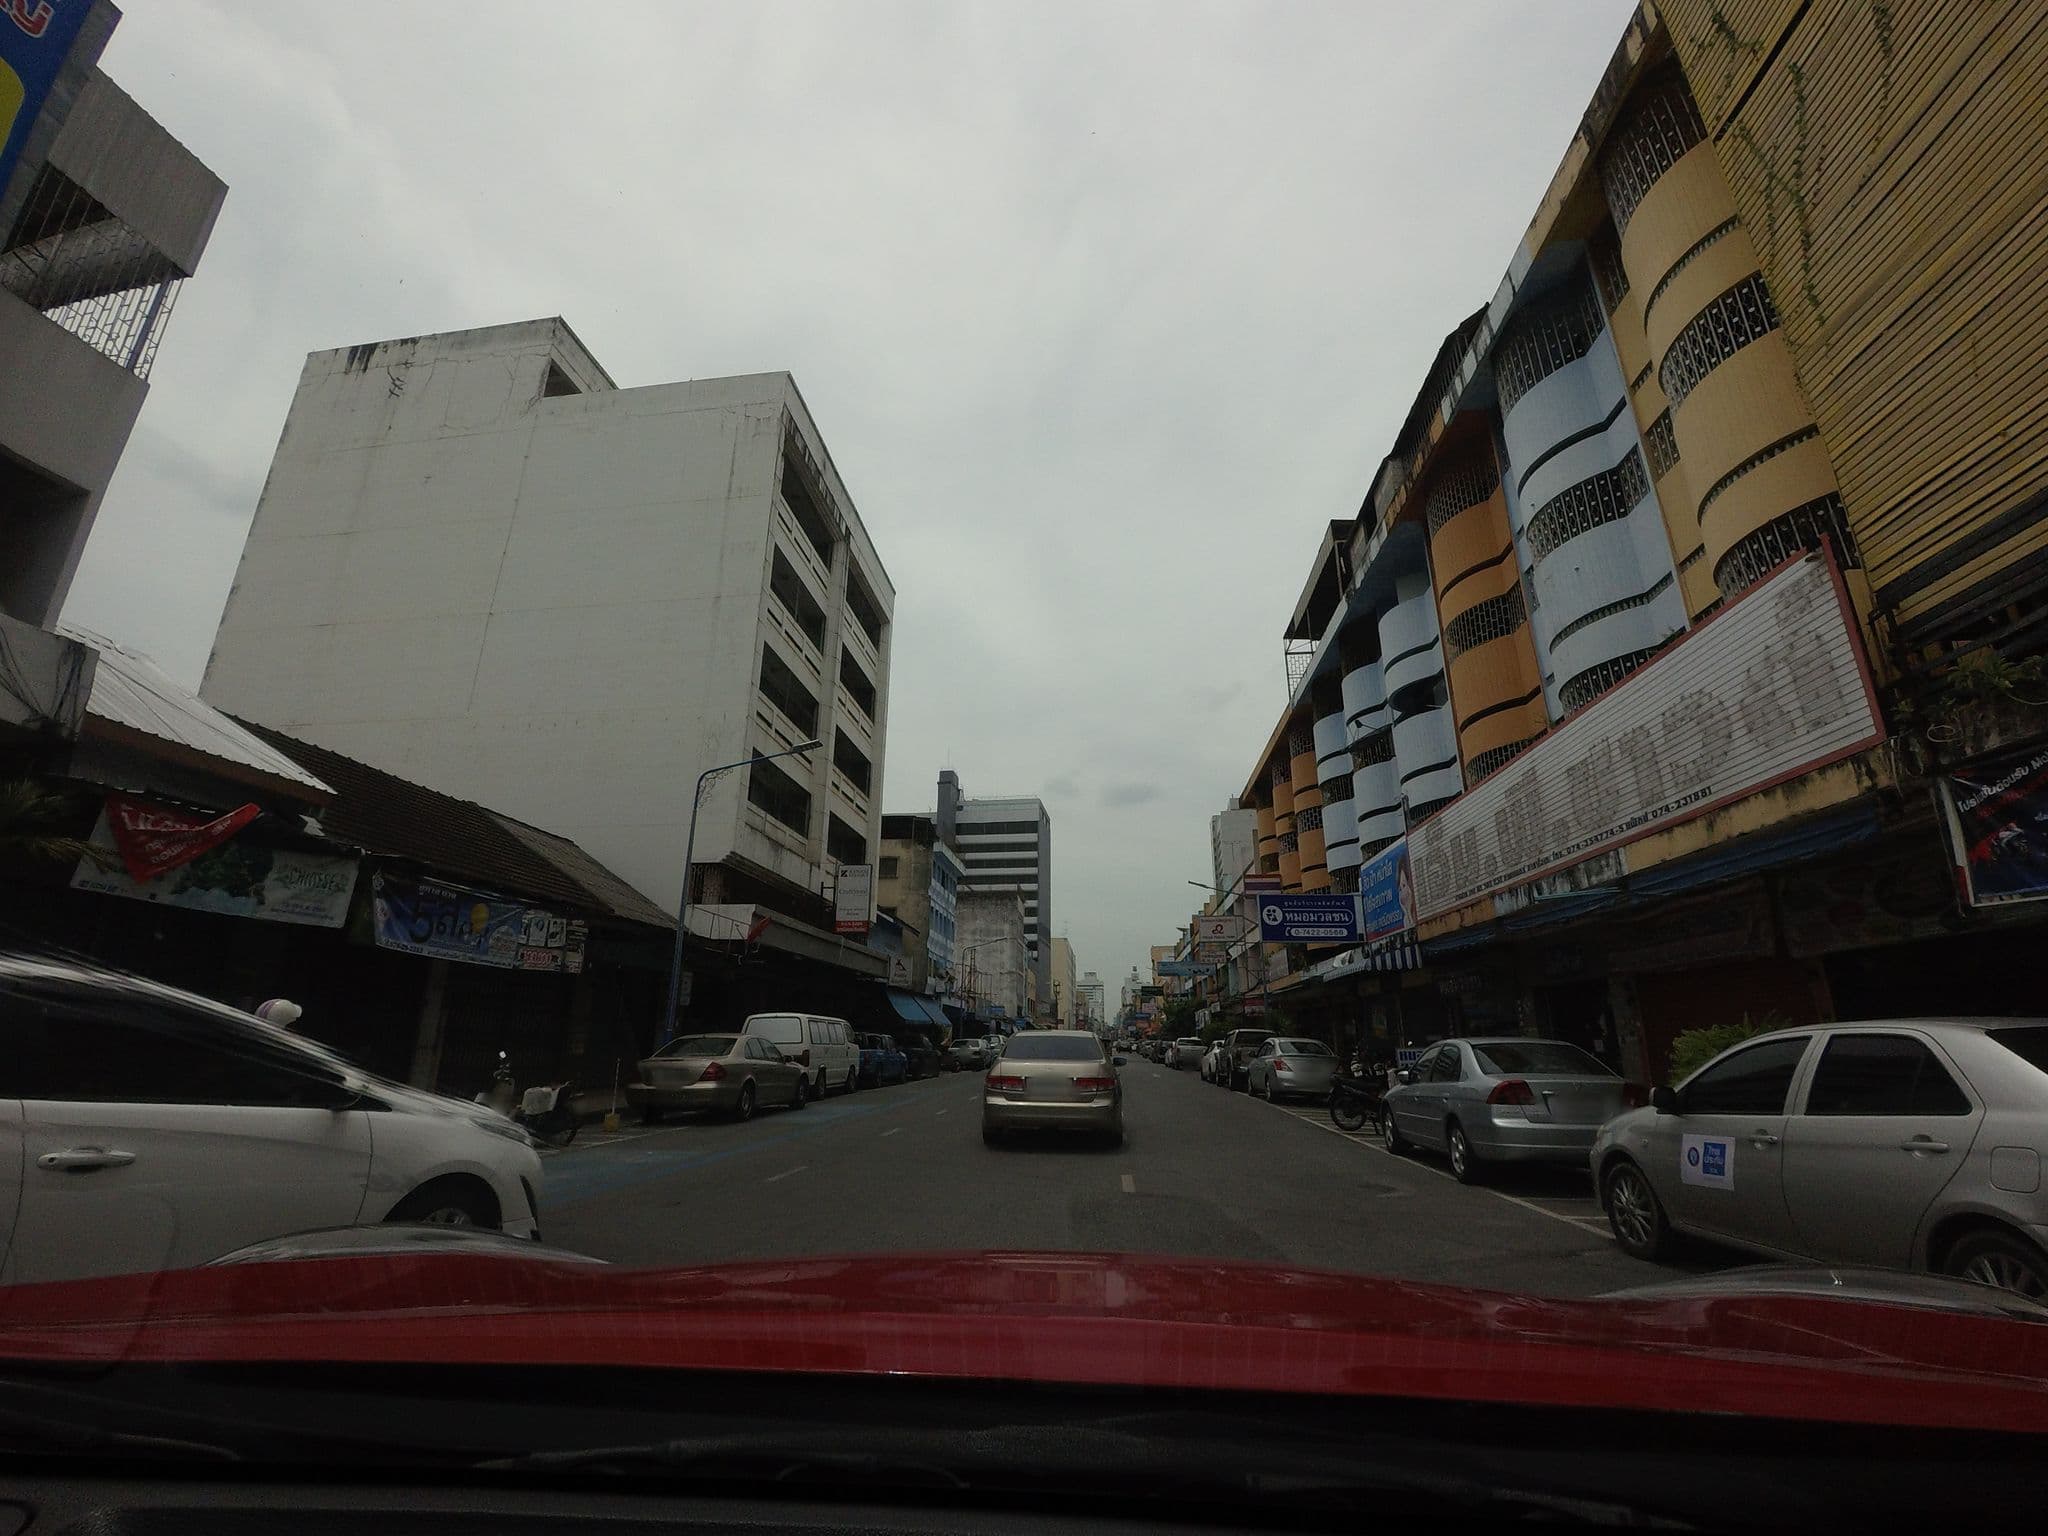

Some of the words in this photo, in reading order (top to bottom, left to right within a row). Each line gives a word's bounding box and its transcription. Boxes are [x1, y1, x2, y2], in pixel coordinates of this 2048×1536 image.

[1651, 786, 1713, 819] 074-231881
[1285, 911, 1350, 922] หมอมวลชน
